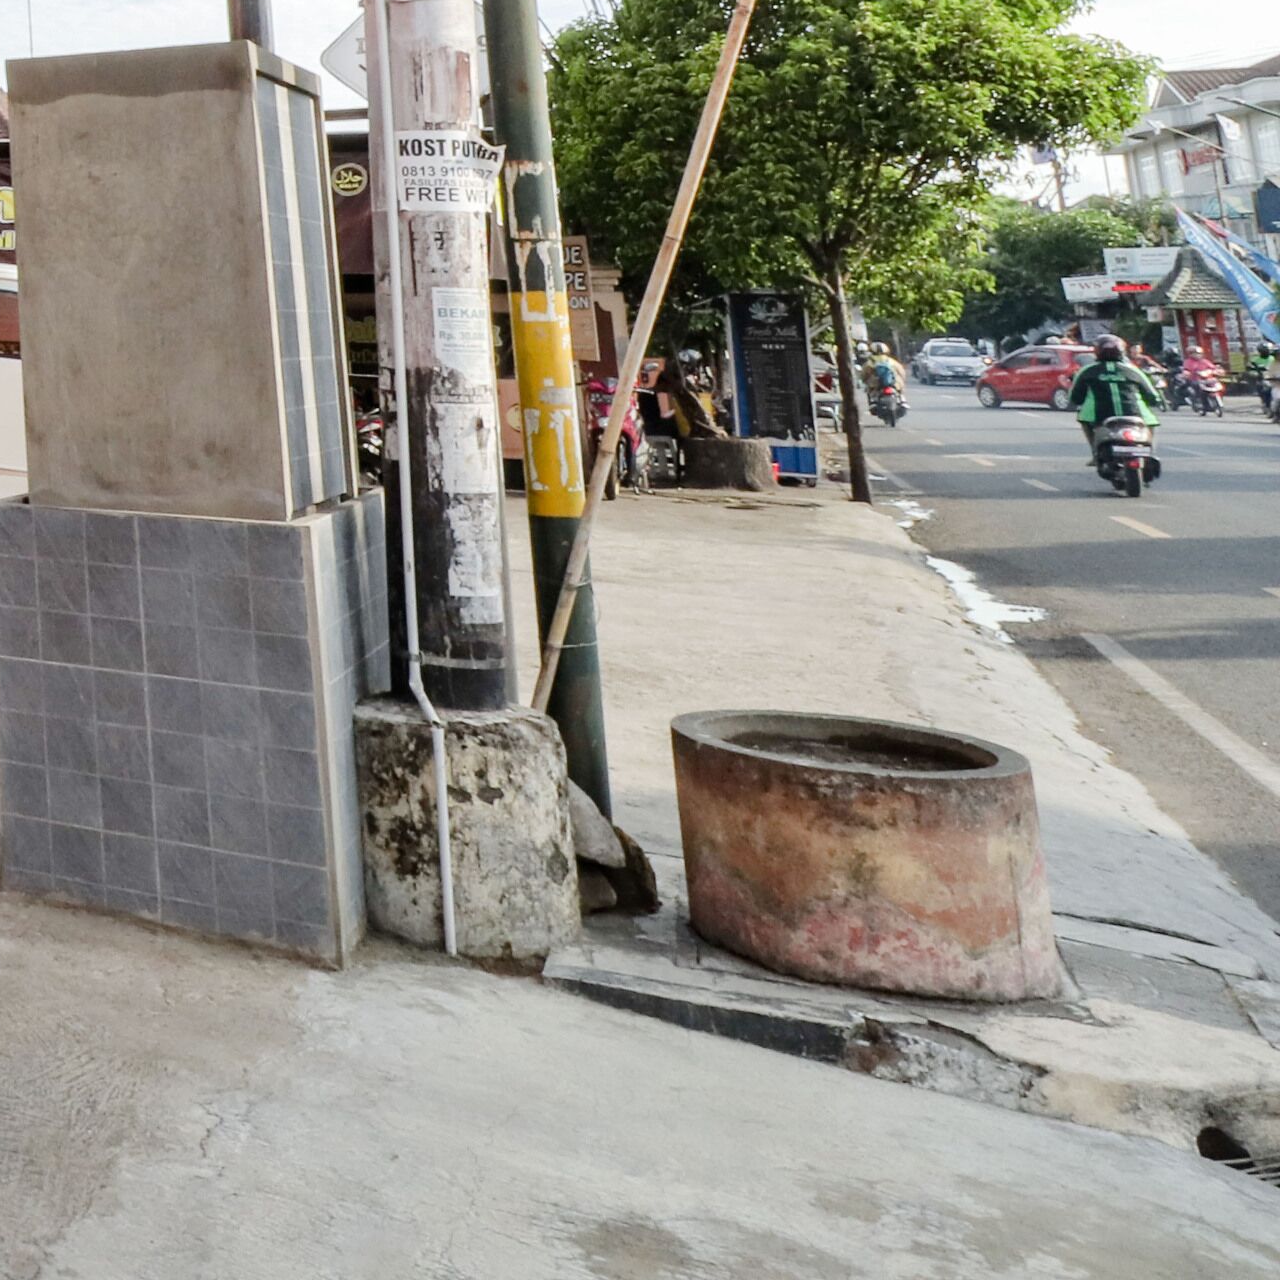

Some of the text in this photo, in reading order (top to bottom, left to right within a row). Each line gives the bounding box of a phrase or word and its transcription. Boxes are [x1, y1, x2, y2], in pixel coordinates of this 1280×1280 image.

[399, 138, 447, 157] KOST
[401, 166, 436, 177] 0813
[403, 179, 456, 187] FASILITAS
[405, 187, 460, 202] FREE
